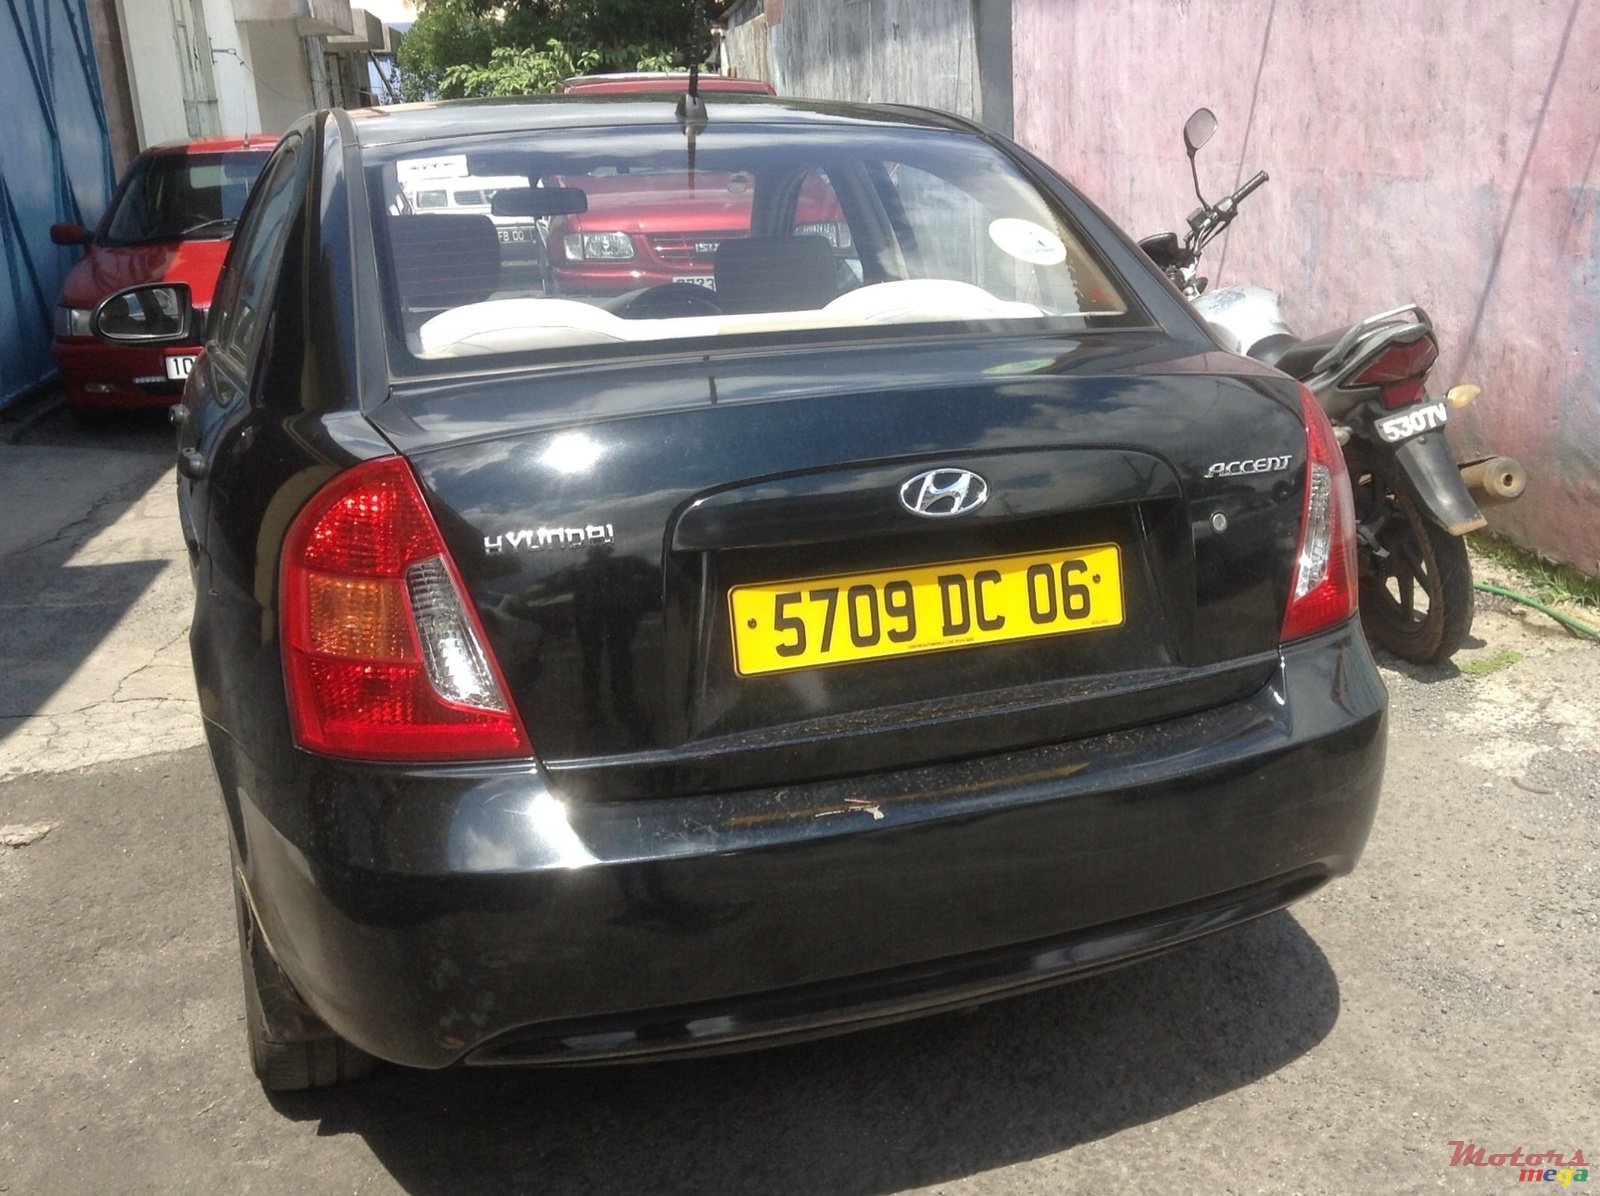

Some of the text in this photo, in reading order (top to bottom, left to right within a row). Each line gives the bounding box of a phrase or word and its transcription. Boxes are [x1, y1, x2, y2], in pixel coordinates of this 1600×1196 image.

[695, 243, 720, 252] ISU
[1204, 455, 1292, 478] ACCENT
[484, 523, 614, 556] HYUNDAI
[773, 559, 1091, 657] 5709 DC 06
